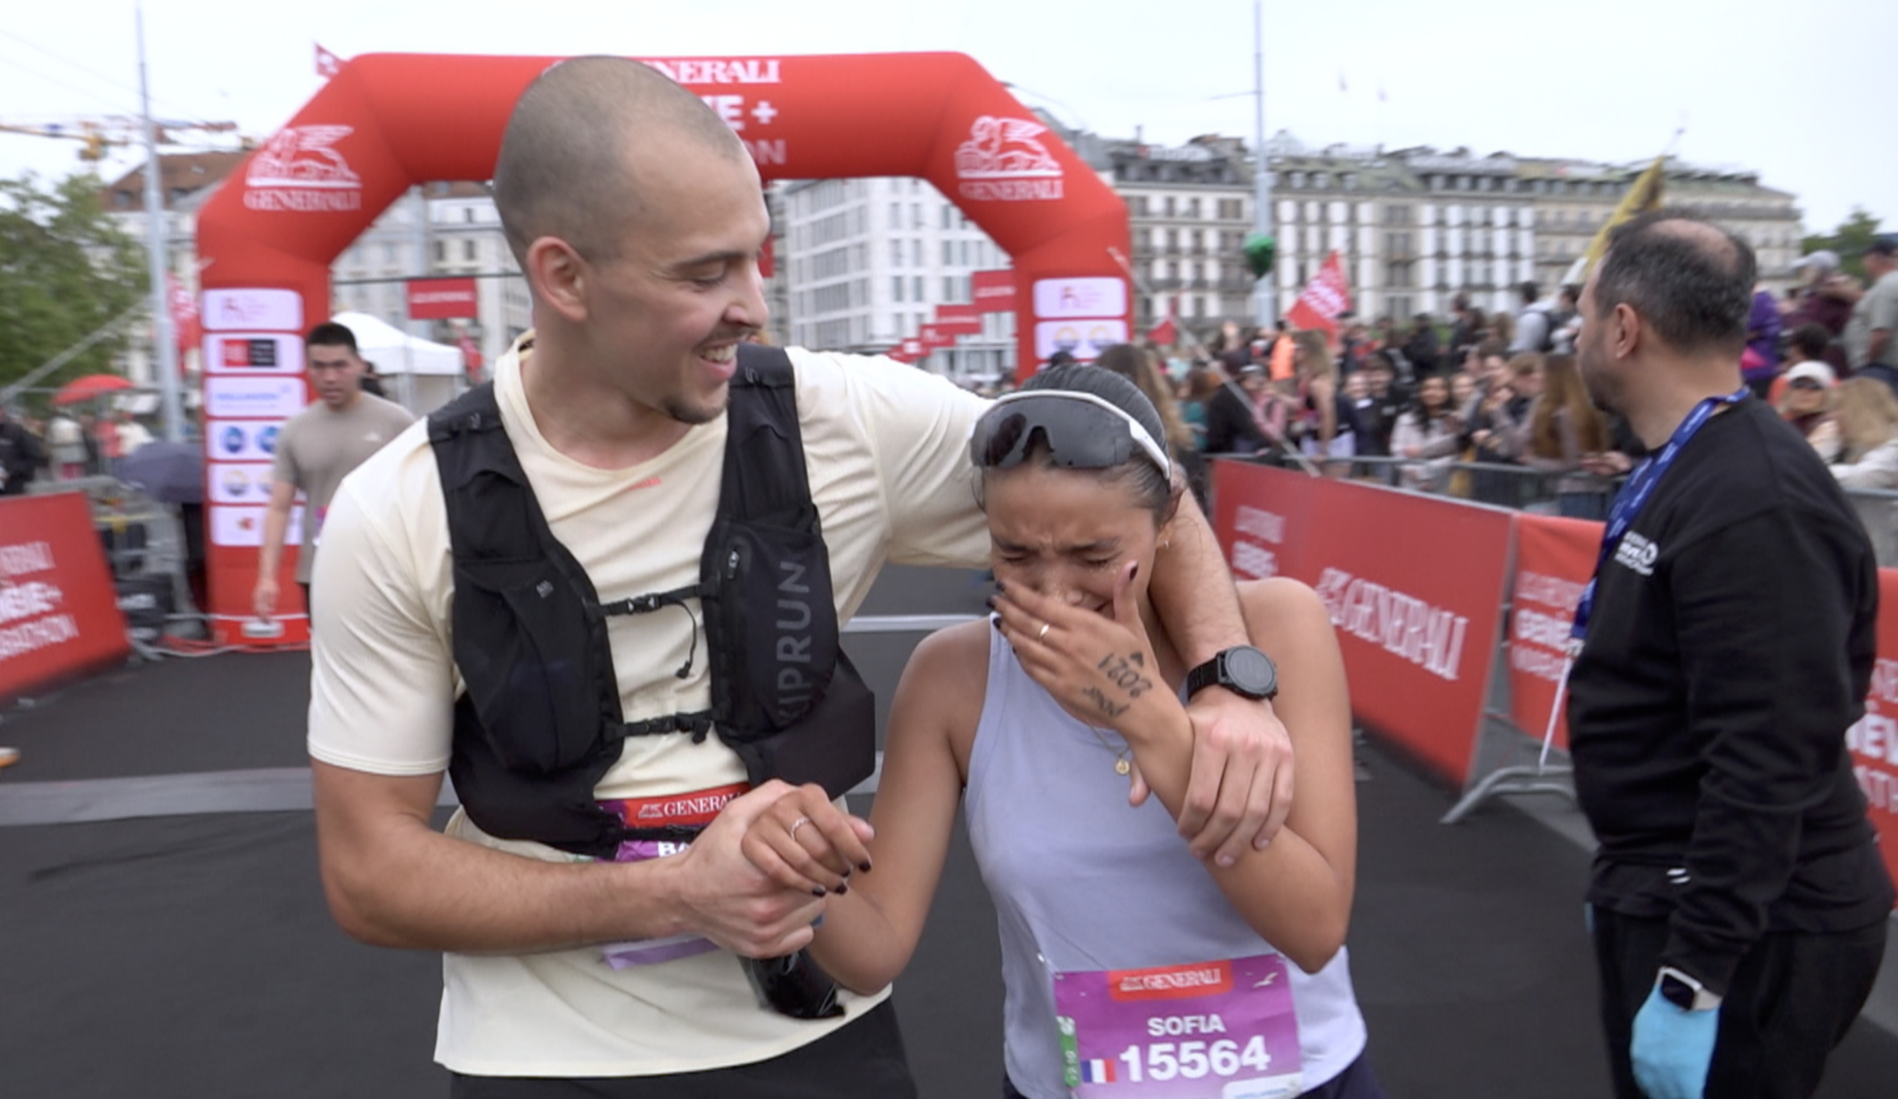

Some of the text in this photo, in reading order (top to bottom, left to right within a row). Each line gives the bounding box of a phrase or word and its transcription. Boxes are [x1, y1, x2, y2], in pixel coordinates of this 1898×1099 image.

[643, 60, 782, 84] NERALI
[959, 180, 1064, 200] GENERALI
[1342, 578, 1469, 681] GENERALI
[1097, 652, 1153, 699] 2021
[1143, 968, 1221, 990] GENERALI
[1148, 1014, 1226, 1036] SOFIA
[1119, 1035, 1271, 1082] 15564
